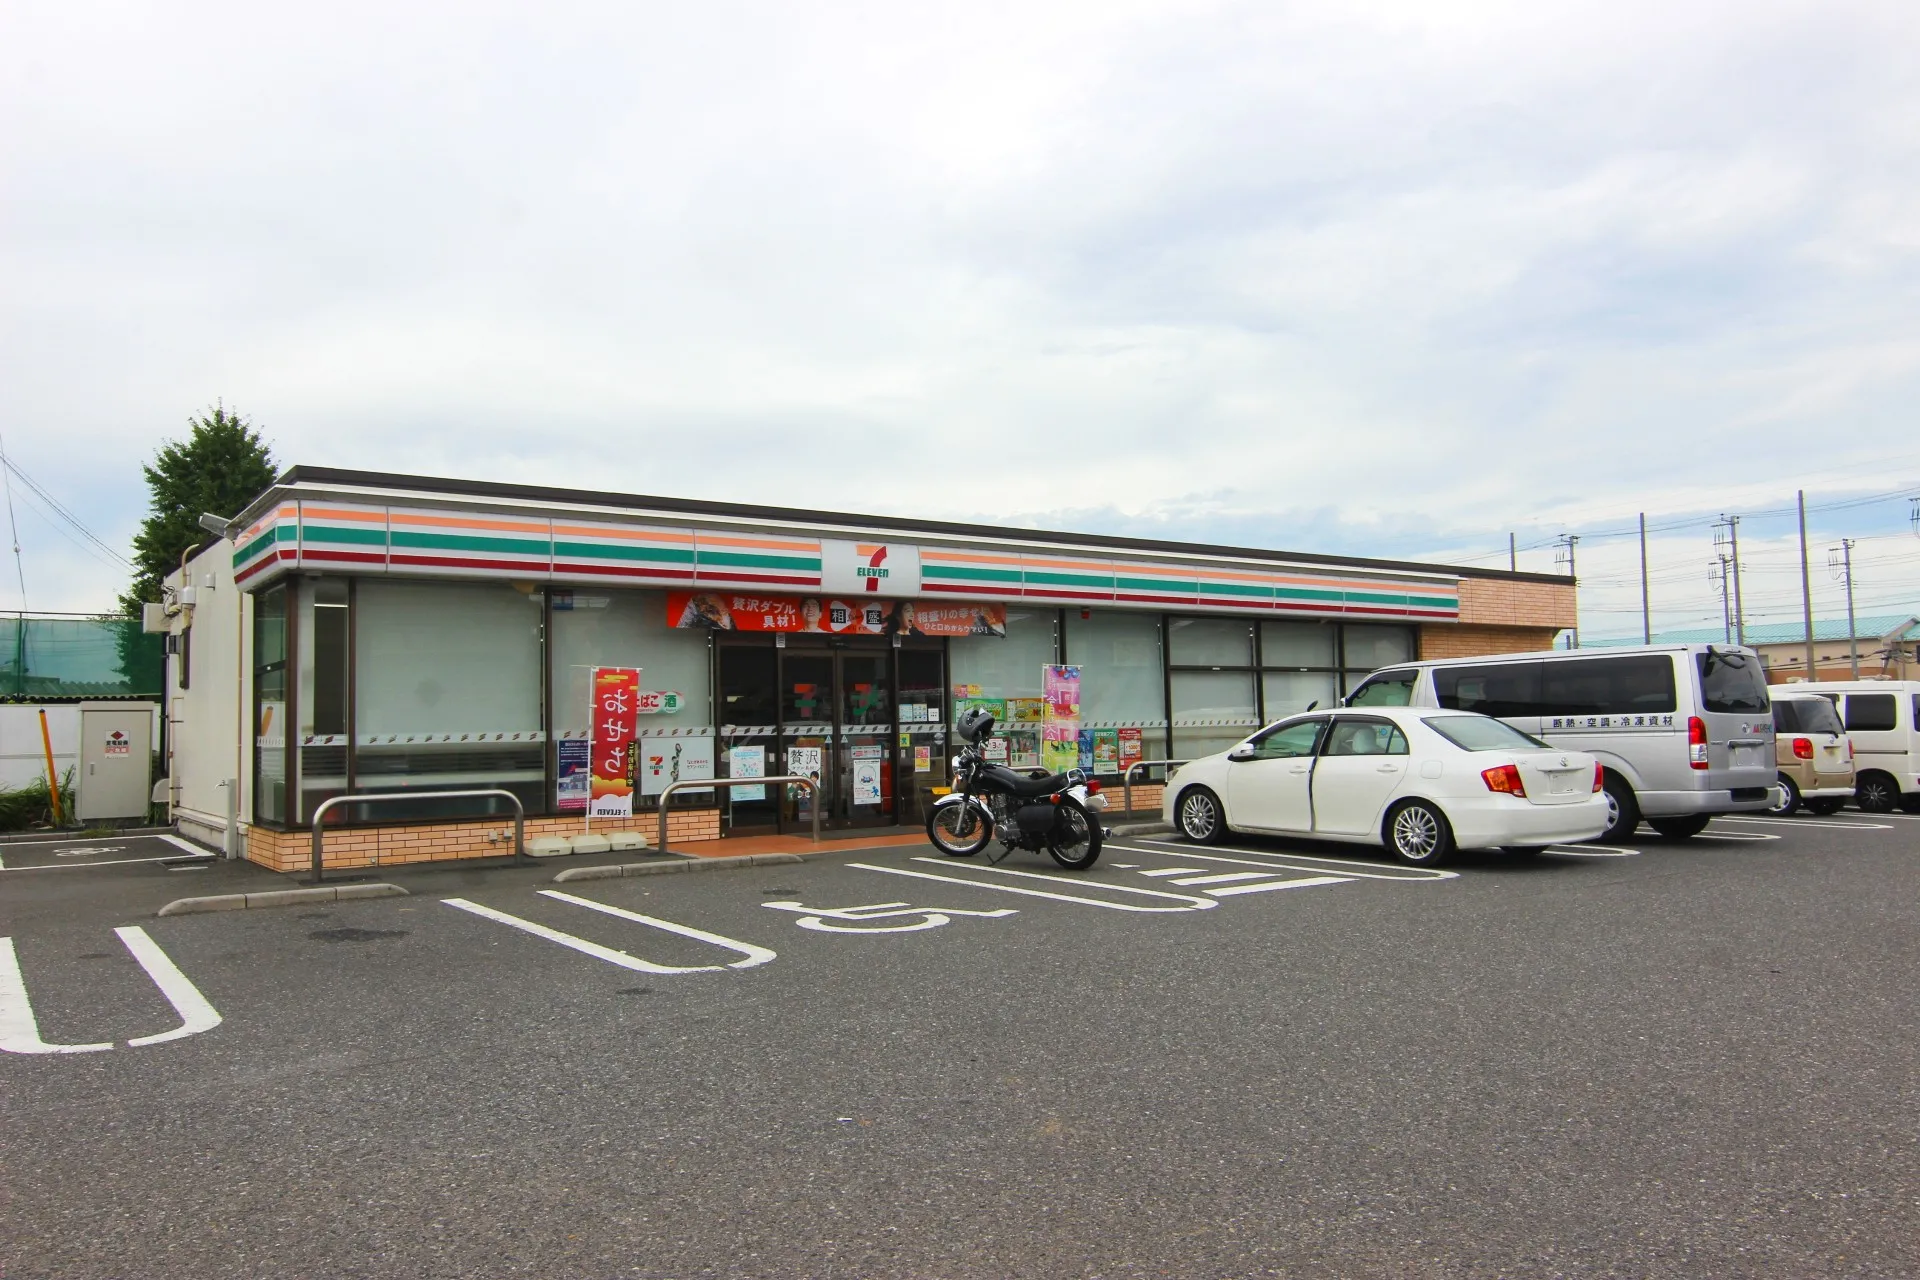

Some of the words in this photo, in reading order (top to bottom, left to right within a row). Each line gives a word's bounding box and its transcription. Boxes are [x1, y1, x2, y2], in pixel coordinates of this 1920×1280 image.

[855, 544, 888, 592] 7
[732, 596, 796, 615] 贅沢ダブル
[762, 614, 797, 629] 具材!
[664, 694, 677, 708] 酒
[1553, 715, 1674, 728] 断熱・空調・冷凍資材
[790, 749, 819, 766] 贅沢
